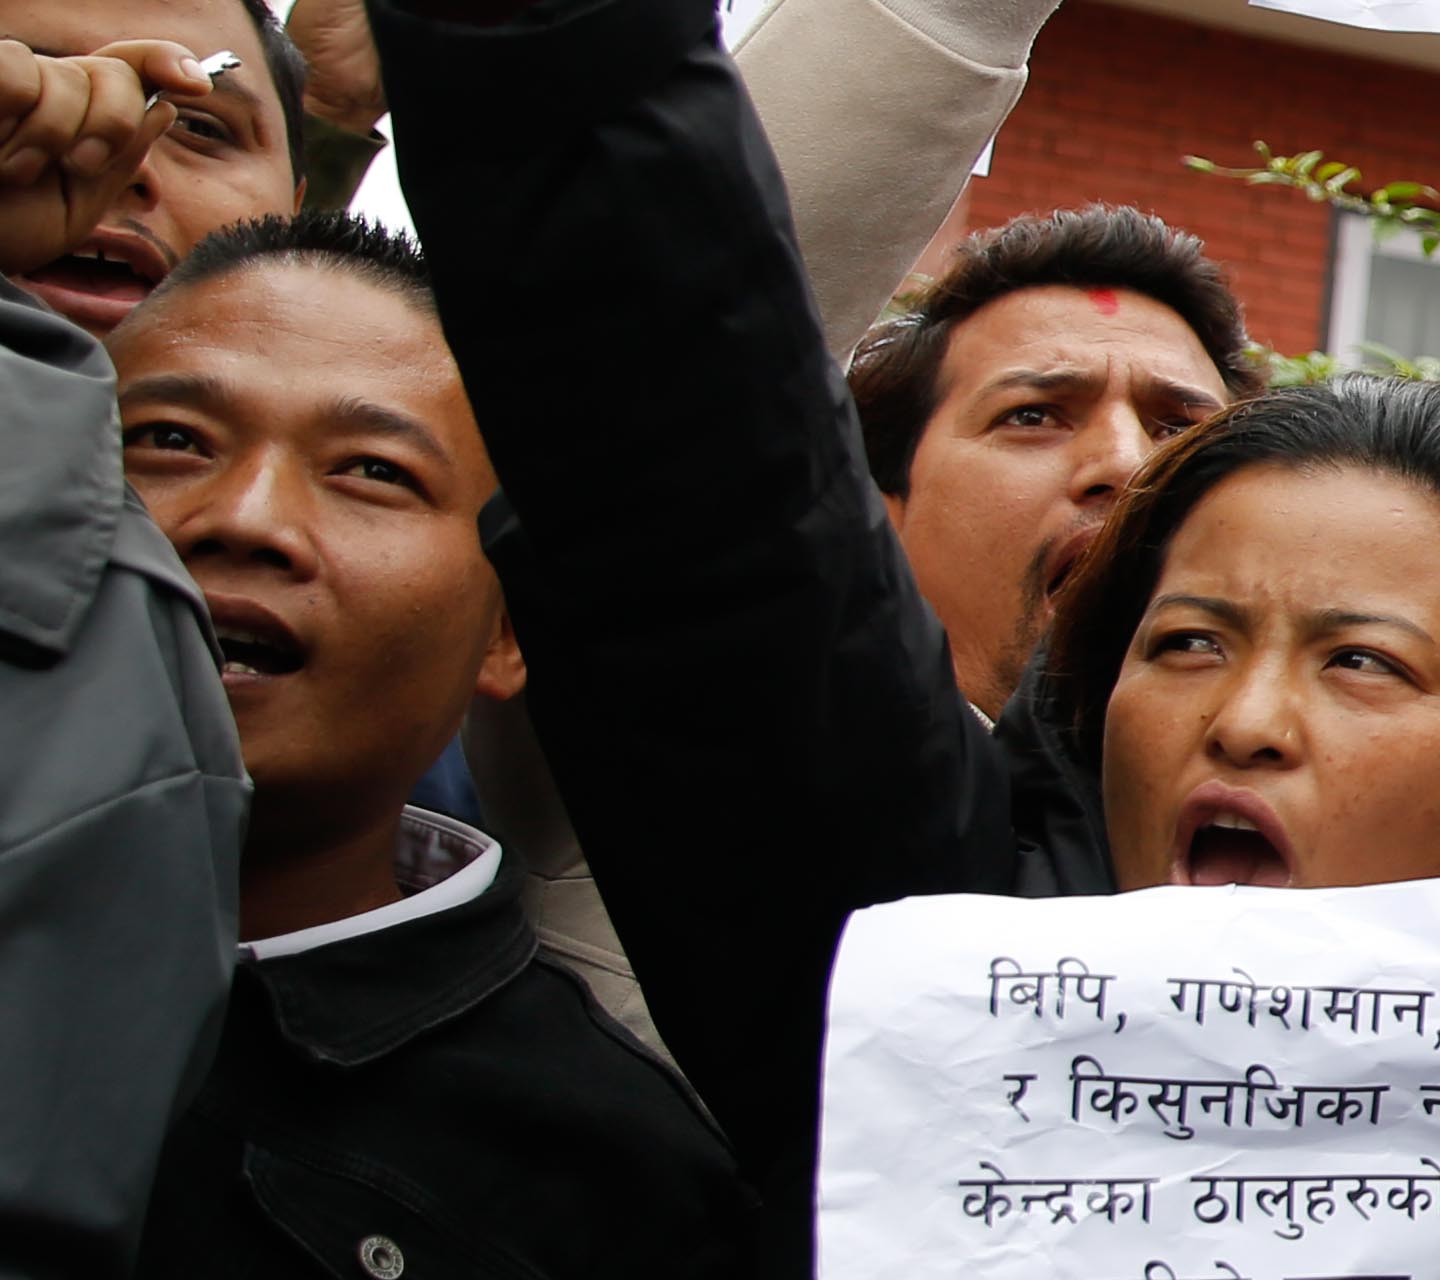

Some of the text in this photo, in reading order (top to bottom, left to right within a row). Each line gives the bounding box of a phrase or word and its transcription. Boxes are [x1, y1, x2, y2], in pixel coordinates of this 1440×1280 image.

[1002, 1074, 1038, 1123] र
[1068, 1054, 1391, 1141] किसुनजिका
[957, 1161, 1160, 1227] केन्द्रका
